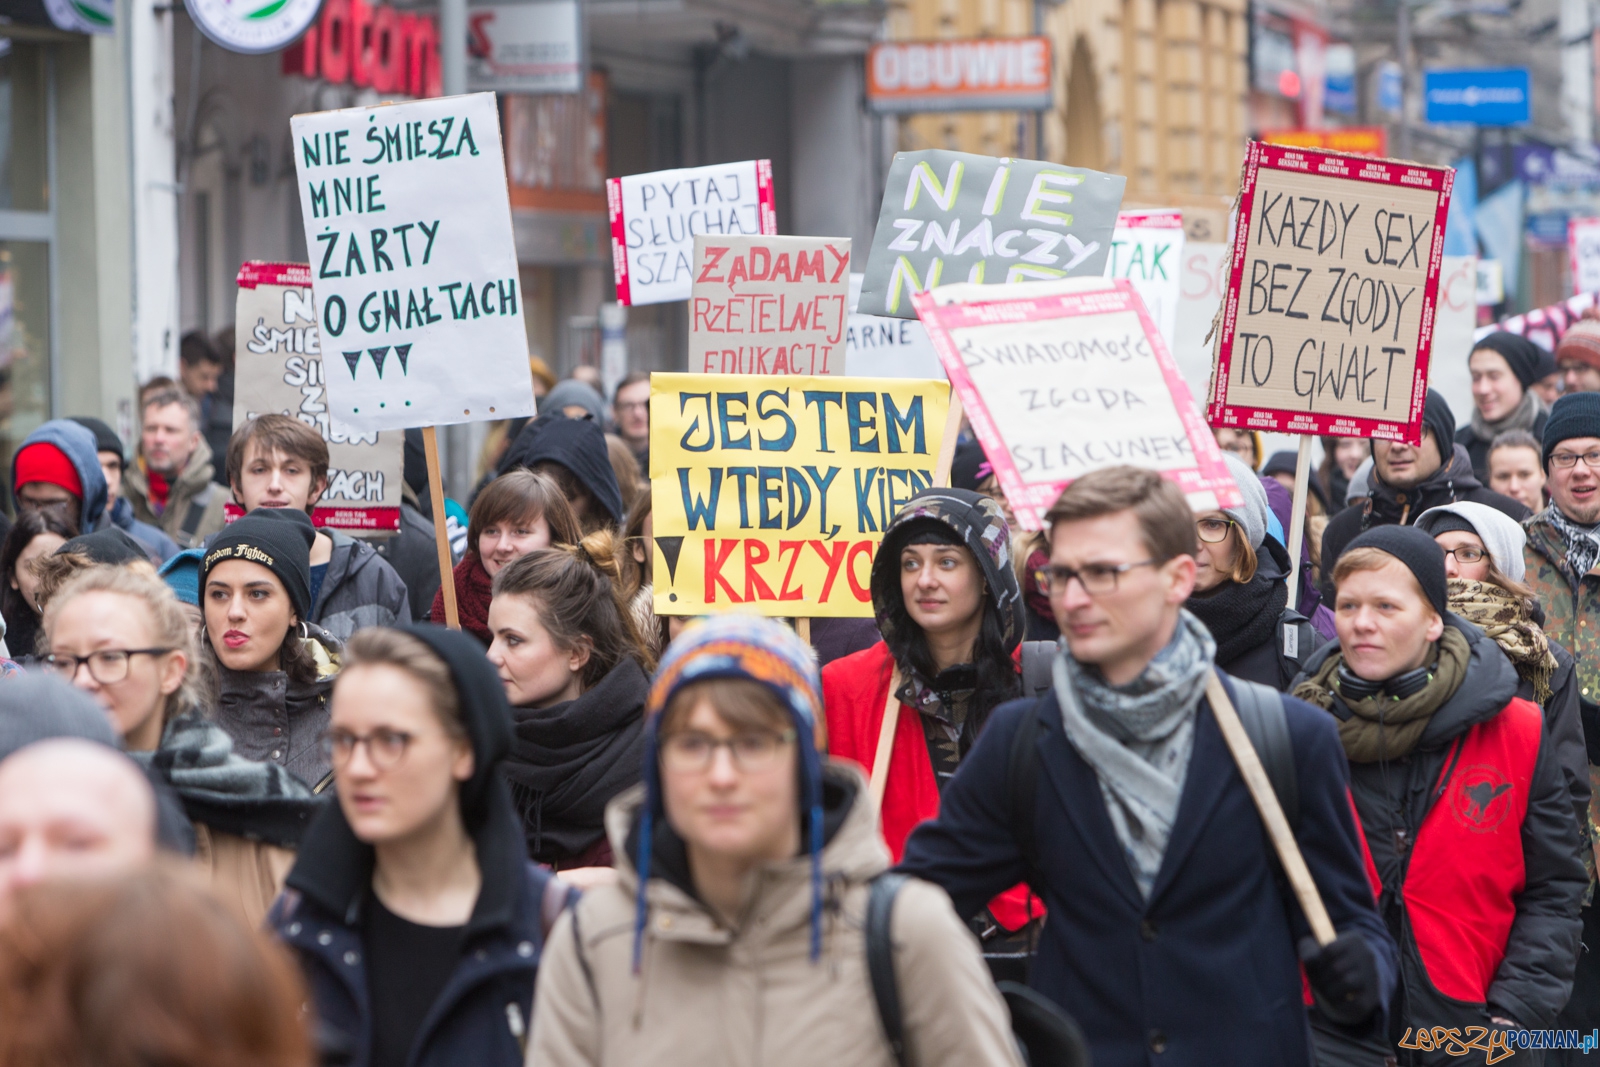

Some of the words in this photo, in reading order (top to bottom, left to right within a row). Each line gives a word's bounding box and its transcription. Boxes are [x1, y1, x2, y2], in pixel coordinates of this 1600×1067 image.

[875, 40, 1047, 88] OBUWIE
[302, 129, 351, 168] NIE
[362, 114, 480, 164] ŚMIESZĄ
[1278, 158, 1299, 168] SEKSIZM
[1300, 161, 1309, 169] NIE
[1318, 163, 1339, 173] SEKSIZM
[1340, 167, 1349, 175] NIE
[1359, 169, 1381, 179] SEKSIZM
[1382, 172, 1390, 181] NIE
[1400, 175, 1422, 185] SEKSIZM
[1423, 178, 1432, 187] NIE
[308, 174, 386, 218] MNIE
[641, 174, 740, 212] PYTAJ
[904, 157, 1086, 226] NIE
[626, 204, 758, 249] SŁUCHAJ
[887, 218, 1100, 272] ZNACZY
[1365, 208, 1430, 269] SEX
[316, 220, 440, 279] ŻARTY
[637, 250, 694, 286] SZA
[1111, 241, 1170, 280] TAK
[324, 294, 347, 337] O
[358, 278, 518, 334] GWAŁTACH
[694, 293, 844, 344] RZETELNEJ
[1248, 260, 1312, 320] BEZ
[1321, 267, 1416, 342] ZGODY
[247, 316, 320, 354] ŚMIE
[846, 320, 912, 350] ARNE
[704, 344, 832, 375] EDUKACJI
[1240, 332, 1273, 386] TO
[1294, 338, 1406, 410] GWAŁT
[1020, 386, 1148, 412] ZGODA
[678, 387, 931, 456] JESTEM
[1247, 418, 1268, 426] SEKSIZM
[1269, 420, 1278, 428] NIE
[1287, 421, 1308, 429] SEKSIZM
[1310, 423, 1319, 431] NIE
[1329, 425, 1351, 434] SEKSIZM
[1352, 428, 1361, 436] NIE
[1371, 429, 1394, 439] SEKSIZM
[1395, 432, 1403, 441] NIE
[1012, 434, 1190, 474] SZACUNEK
[676, 466, 842, 541] WTEDY,
[205, 547, 232, 572] Freedom
[234, 544, 274, 566] Fighters
[704, 538, 880, 604] KRZYC
